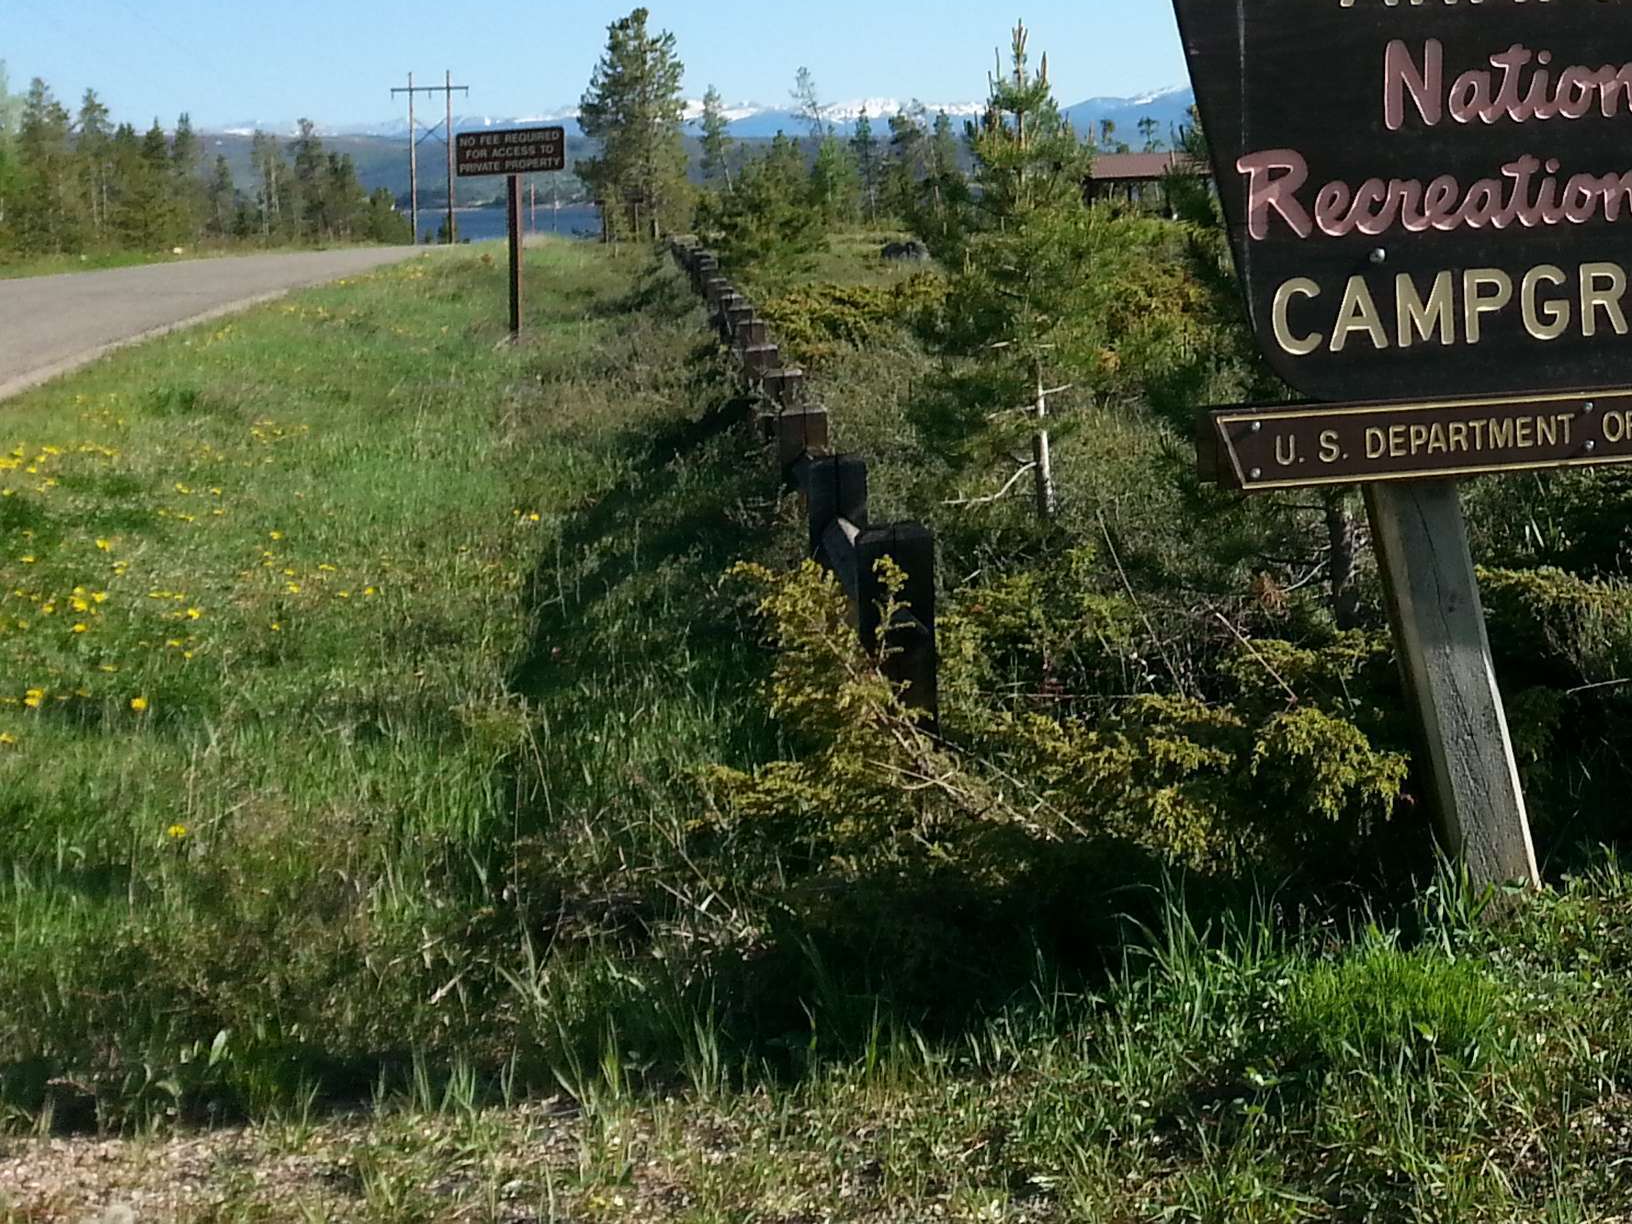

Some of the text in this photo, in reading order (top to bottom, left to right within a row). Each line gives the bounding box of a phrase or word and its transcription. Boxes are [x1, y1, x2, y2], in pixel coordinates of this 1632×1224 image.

[460, 131, 559, 147] NO FEE REQUIRED
[466, 145, 554, 159] FOR ACCESS TO
[460, 157, 560, 173] PRIVATE PROPERTY
[1365, 413, 1575, 459] DEPARTMENT
